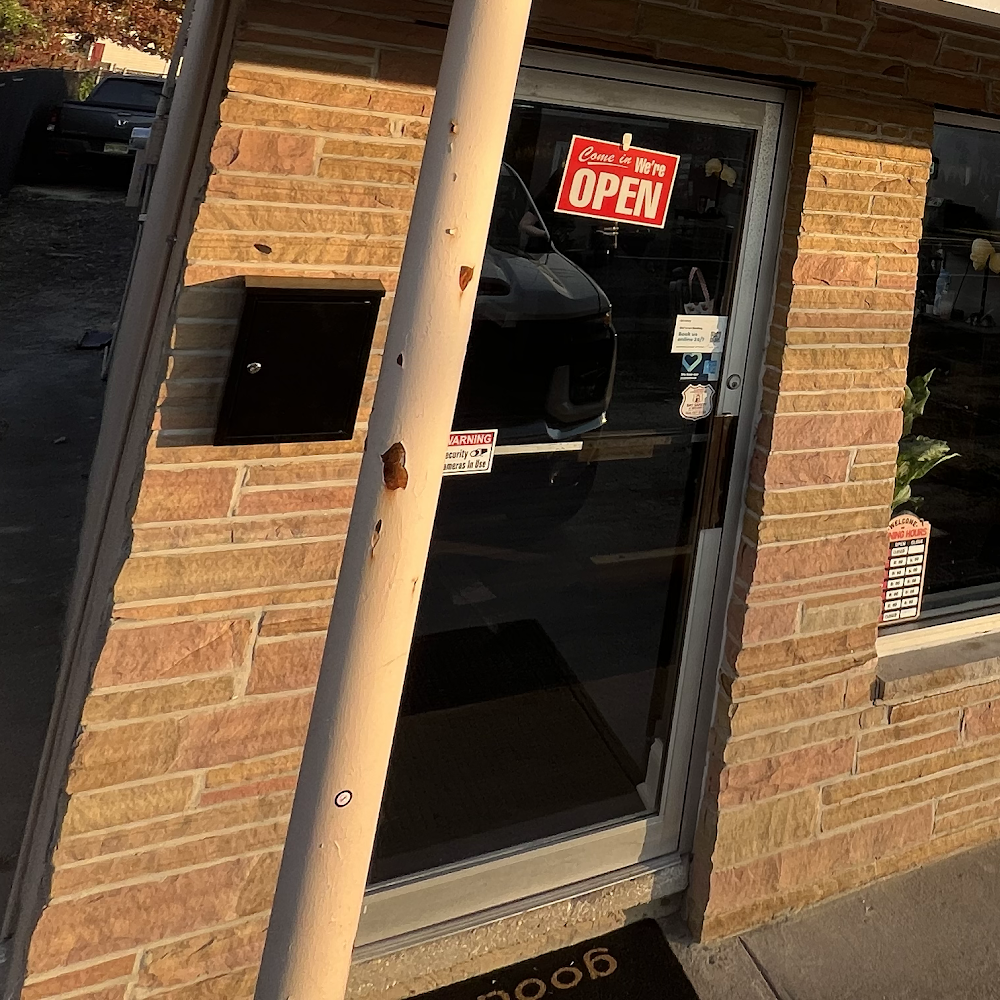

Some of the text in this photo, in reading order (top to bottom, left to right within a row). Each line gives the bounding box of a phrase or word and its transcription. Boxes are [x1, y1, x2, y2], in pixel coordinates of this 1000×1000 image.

[578, 145, 666, 178] Come in We're
[568, 167, 663, 219] OPEN
[443, 463, 466, 471] ameras
[475, 459, 486, 468] Use
[445, 449, 468, 460] ecurity
